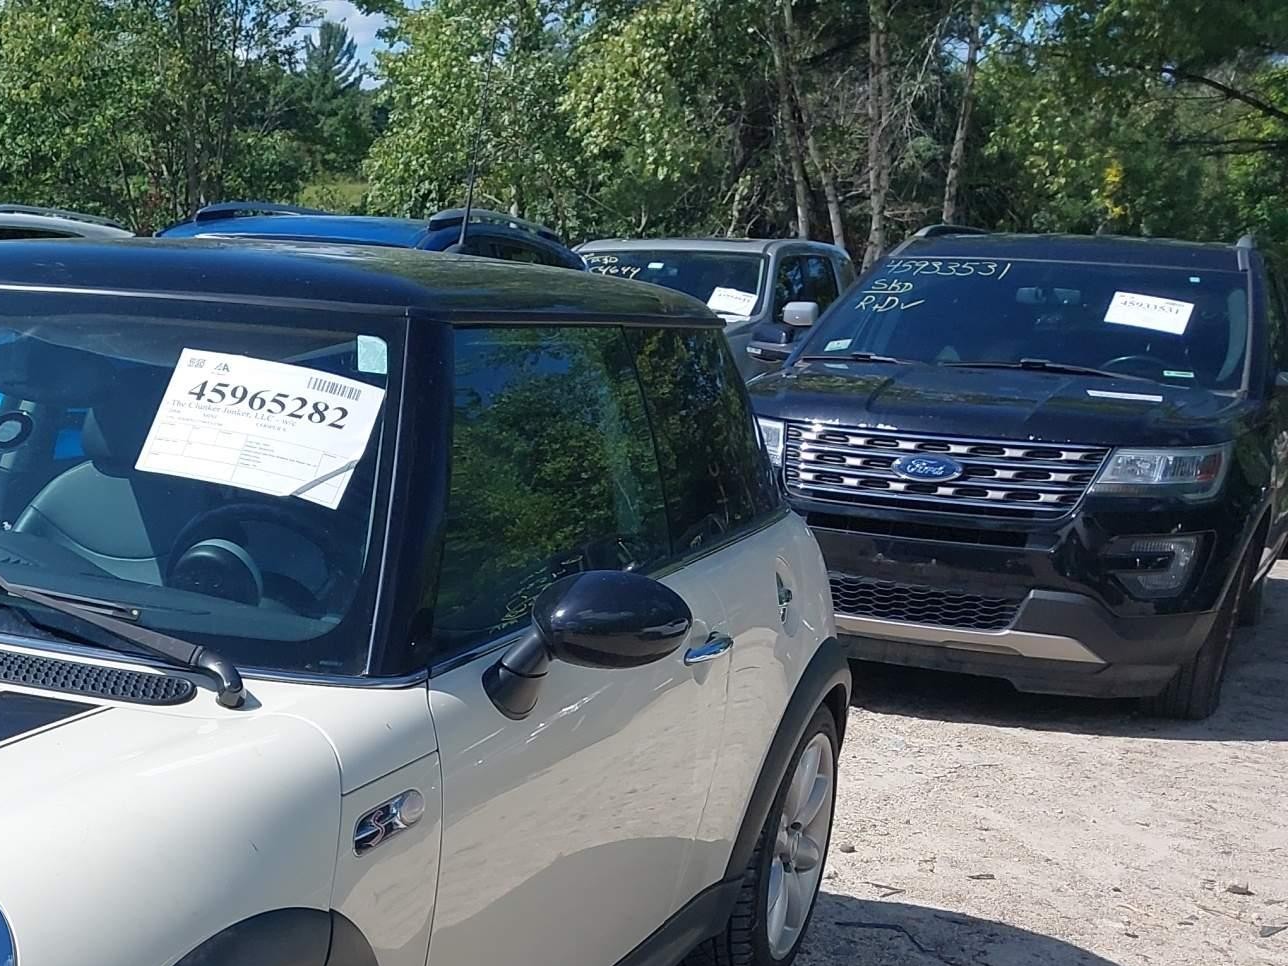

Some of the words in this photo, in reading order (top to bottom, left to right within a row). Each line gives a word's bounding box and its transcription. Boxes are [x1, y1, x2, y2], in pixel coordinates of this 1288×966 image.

[886, 259, 1011, 280] 45933531
[187, 379, 350, 430] 45965282
[254, 412, 274, 423] LLC
[906, 459, 947, 476] Ford
